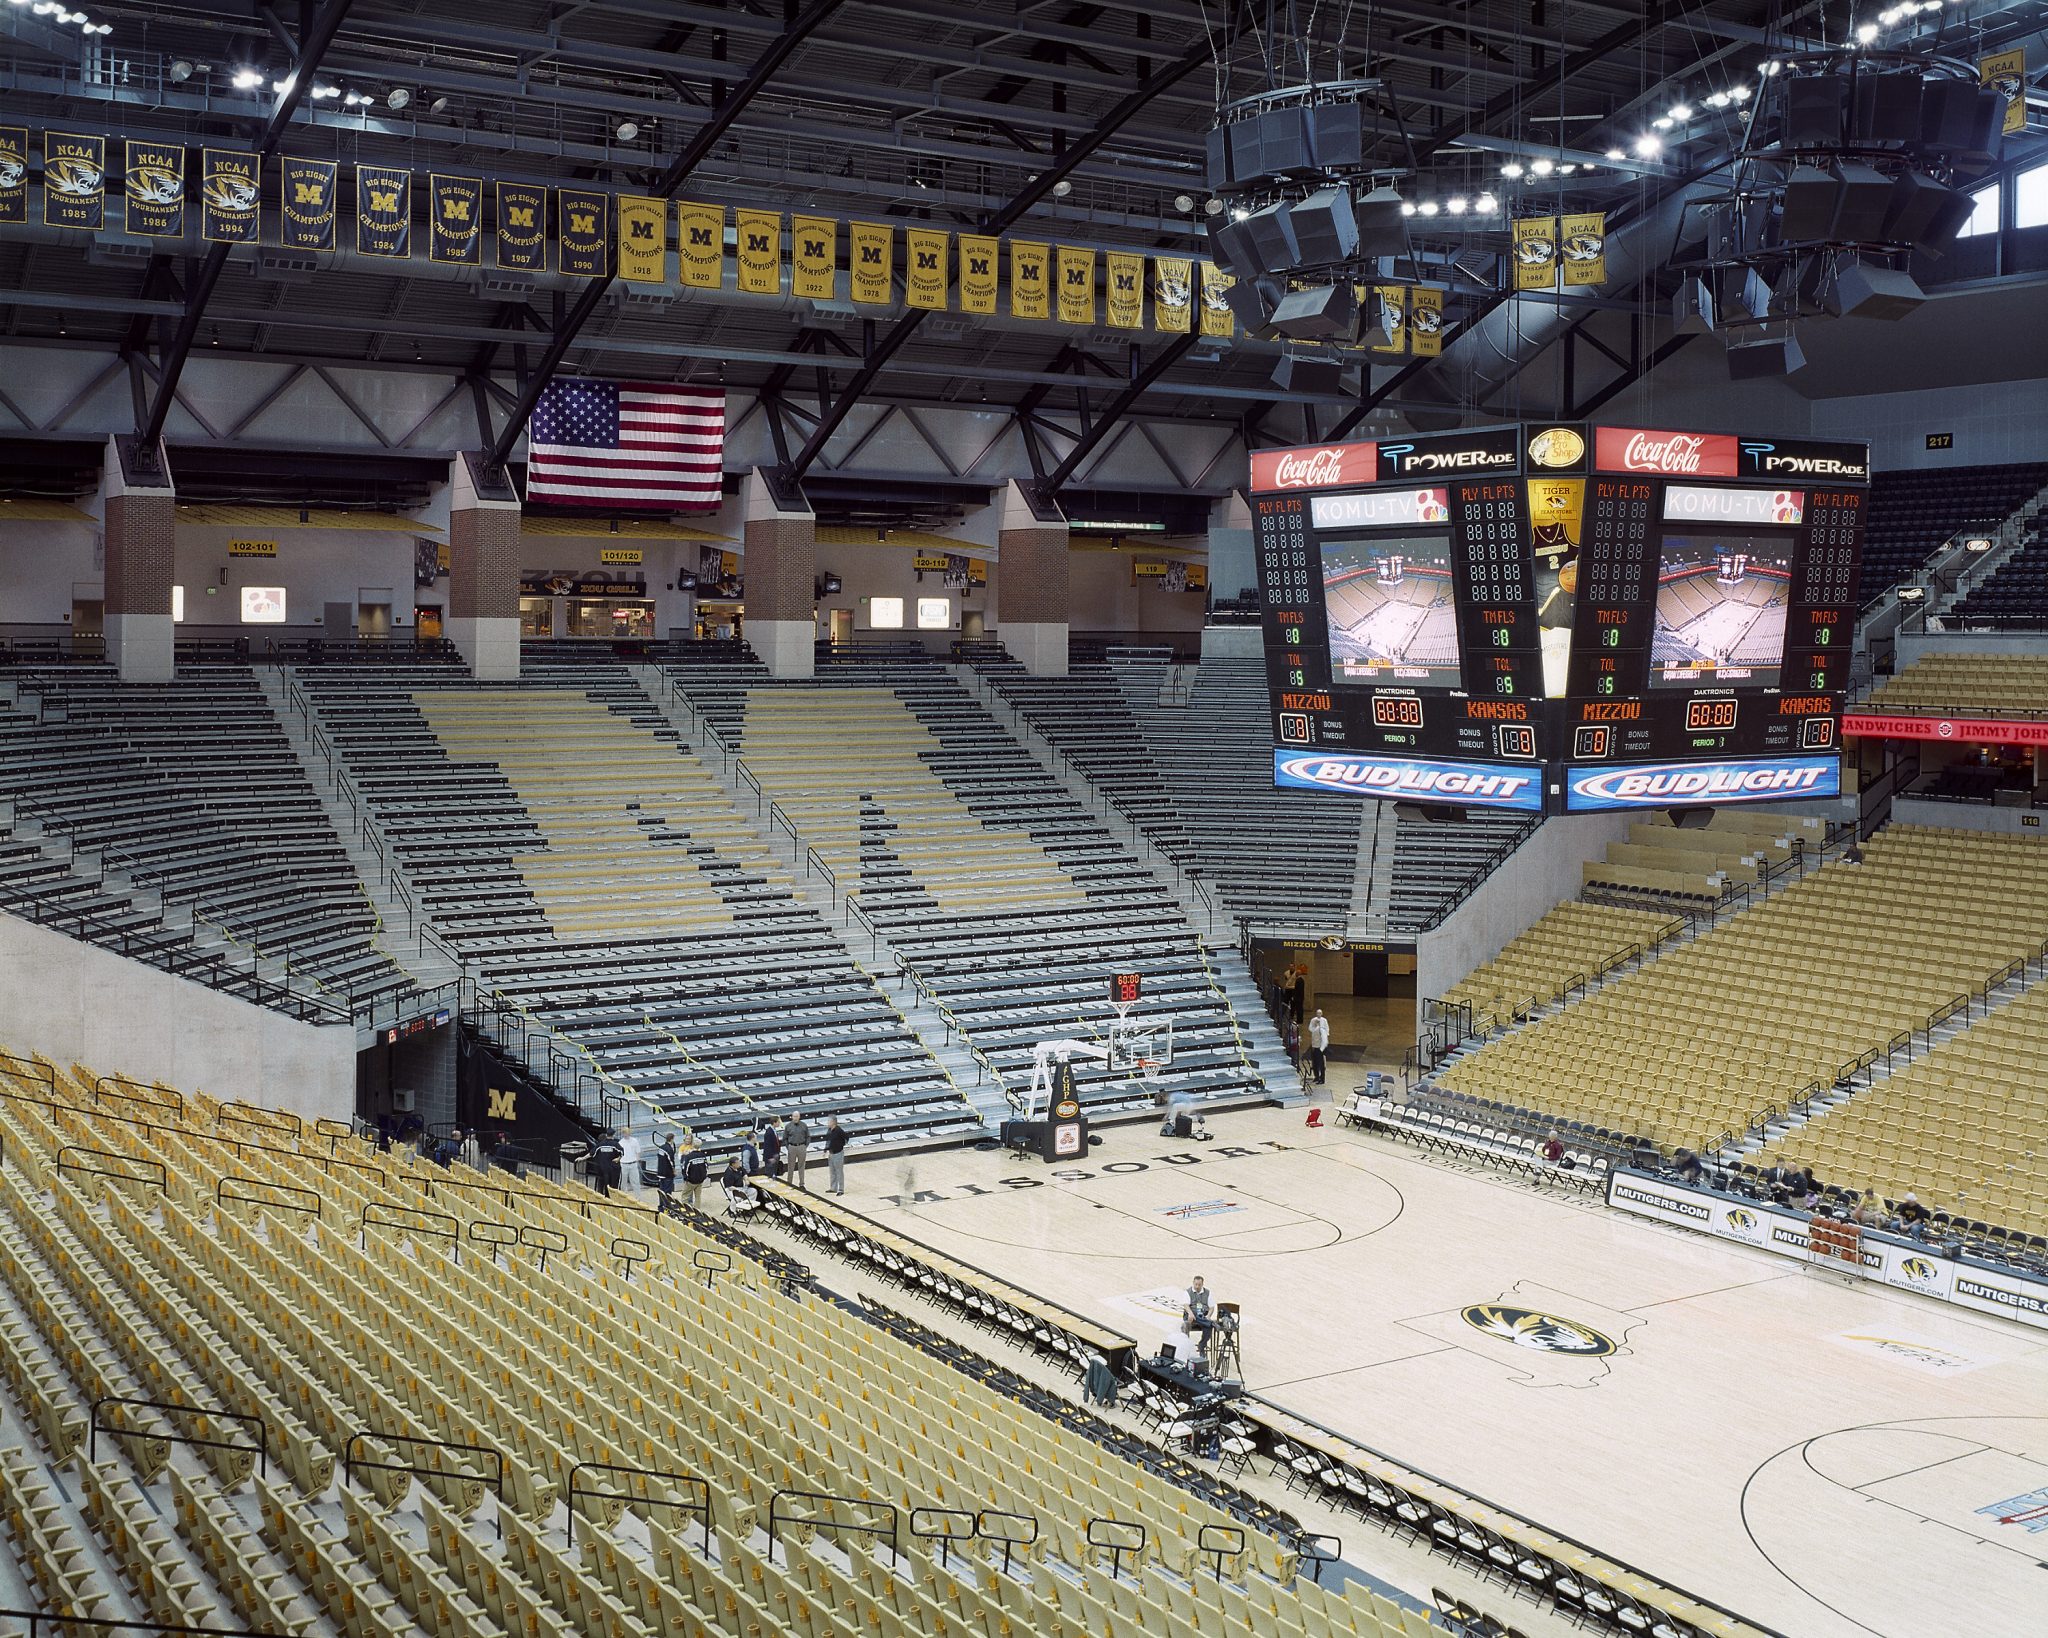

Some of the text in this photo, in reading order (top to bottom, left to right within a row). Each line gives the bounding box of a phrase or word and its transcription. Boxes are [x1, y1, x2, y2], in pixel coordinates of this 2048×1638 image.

[1988, 61, 2014, 75] NCAA
[57, 144, 94, 159] NCAA
[137, 153, 174, 168] NCAA
[214, 161, 250, 175] NCAA
[290, 170, 330, 183] BIG EIGHT
[365, 178, 404, 191] BIG EIGHT
[50, 191, 99, 205] TOURNAMENT
[295, 183, 323, 205] M
[439, 186, 476, 199] BIG EIGHT
[370, 191, 398, 213] M
[504, 194, 540, 206] BIG EIGHT
[61, 208, 87, 219] 1985
[131, 201, 179, 214] TOURNAMENT
[208, 207, 255, 220] TOURNAMENT
[443, 199, 470, 221] M
[566, 201, 601, 214] BIG EIGHT
[284, 205, 334, 225] CHAMPIONS
[509, 206, 534, 228] M
[143, 217, 167, 227] 1986
[219, 223, 245, 234] 1994
[360, 213, 408, 232] CHAMPIONS
[570, 213, 595, 234] M
[433, 221, 480, 240] CHAMPIONS
[631, 220, 654, 240] M
[1521, 228, 1547, 237] NCAA
[1570, 225, 1596, 234] NCAA
[297, 233, 320, 243] 1978
[499, 228, 544, 246] CHAMPIONS
[561, 234, 605, 253] CHAMPIONS
[690, 227, 713, 247] M
[748, 233, 770, 253] M
[857, 234, 887, 245] BIG EIGHT
[373, 241, 395, 250] 1984
[621, 241, 664, 258] CHAMPIONS
[804, 239, 826, 259] M
[914, 240, 943, 251] BIG EIGHT
[446, 248, 466, 257] 1985
[511, 254, 531, 263] 1987
[680, 247, 722, 265] CHAMPIONS
[861, 246, 882, 264] M
[573, 261, 593, 270] 1990
[739, 253, 777, 271] CHAMPIONS
[917, 251, 938, 270] M
[970, 258, 989, 275] M
[633, 266, 652, 275] 1918
[796, 260, 835, 277] CHAMPIONS
[1021, 264, 1040, 281] M
[1163, 268, 1184, 279] NCAA
[692, 272, 710, 281] 1920
[750, 278, 767, 287] 1921
[854, 273, 889, 286] CHAMPIONS
[1066, 268, 1085, 286] M
[1116, 274, 1135, 291] M
[806, 284, 823, 292] 1922
[910, 279, 944, 292] CHAMPIONS
[963, 284, 996, 297] CHAMPIONS
[863, 289, 880, 298] 1978
[1014, 290, 1046, 302] CHAMPIONS
[1418, 297, 1437, 307] NCAA
[1929, 436, 1950, 446] 217
[1462, 485, 1515, 501] PLY FL PTS
[1542, 487, 1570, 495] TIGER
[1598, 484, 1650, 499] PLY FL PTS
[1259, 500, 1302, 514] PLY FL PTS
[1813, 493, 1860, 508] PLY FL PTS
[233, 543, 273, 551] 102-101
[604, 552, 639, 560] 101/120
[1287, 654, 1302, 666] TOL
[1494, 658, 1512, 671] TOL
[1600, 658, 1616, 671] TOL
[1812, 655, 1827, 668] TOL
[1282, 694, 1331, 710] MIZZOU
[1779, 697, 1832, 715] KANSAS
[1467, 701, 1527, 720] KANSAS
[1583, 703, 1641, 720] MIZZOU
[1323, 721, 1342, 729] BONUS
[1768, 725, 1788, 734] BONUS
[1960, 725, 2010, 738] JIMMY
[1322, 731, 1345, 740] TIMEOUT
[1384, 734, 1406, 743] PERIOD
[1459, 728, 1481, 737] BONUS
[1457, 740, 1485, 749] TIMEOUT
[1624, 742, 1651, 750] TIMEOUT
[1692, 738, 1715, 747] PERIOD
[1765, 736, 1789, 744] TIMEOUT
[1314, 762, 1529, 798] BUD LIGHT
[1615, 767, 1827, 798] BUD LIGHT
[1283, 941, 1318, 949] MIZZOU
[1118, 974, 1140, 985] 60:00
[1062, 1075, 1071, 1100] GHP
[487, 1088, 517, 1121] M
[1411, 1153, 1603, 1209] NORM STEWART
[1616, 1186, 1709, 1220] MUTIGERS.COM
[1715, 1228, 1763, 1245] MUTIGERS.COM
[1889, 1278, 1944, 1298] MUTIGERS.COM
